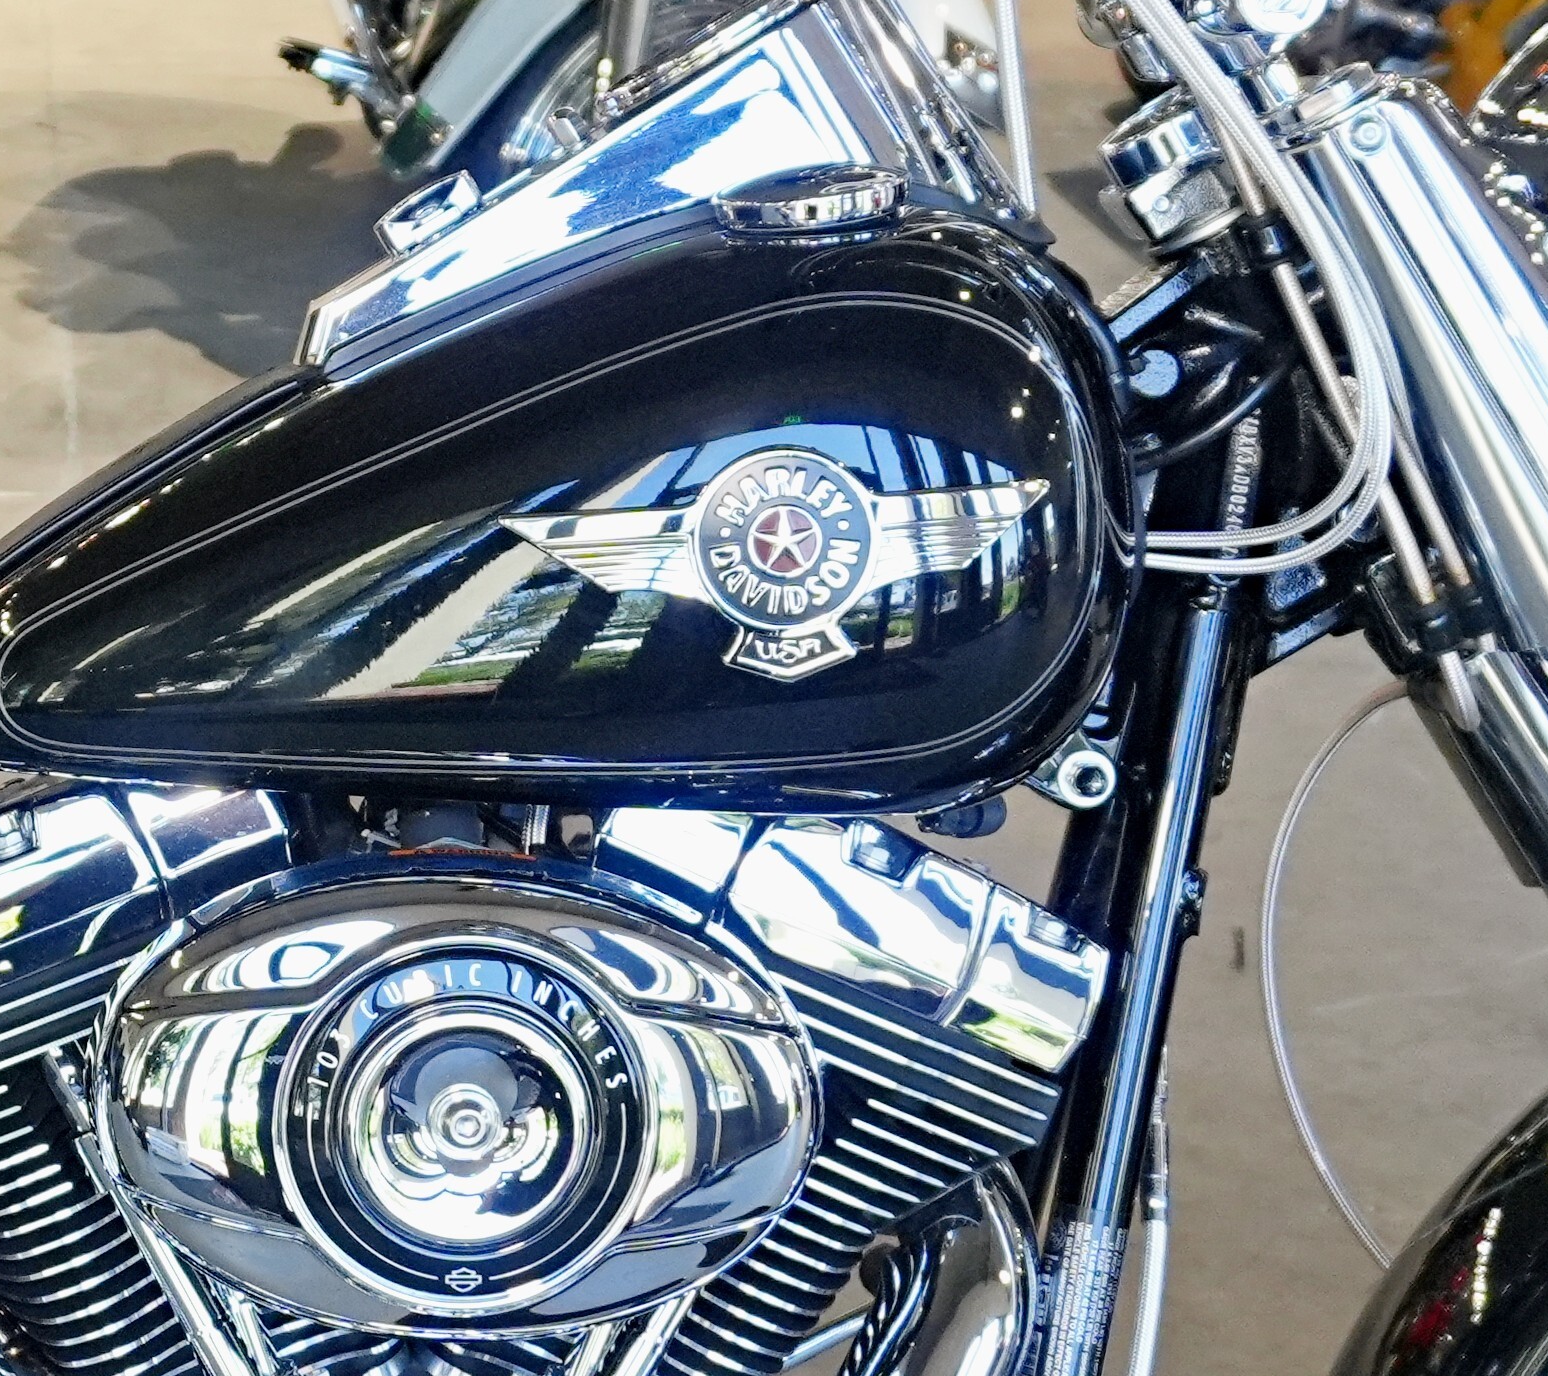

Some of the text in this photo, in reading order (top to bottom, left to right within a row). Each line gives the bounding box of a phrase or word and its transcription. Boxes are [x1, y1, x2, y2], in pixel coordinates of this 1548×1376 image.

[715, 466, 853, 527] HARLEY
[709, 538, 861, 615] DAVIDSON
[754, 637, 822, 664] USA
[307, 962, 628, 1090] 103 CUIC INCHES
[1066, 1219, 1076, 1235] THE
[1072, 1220, 1085, 1254] VEHICLE
[1083, 1222, 1093, 1241] THIS
[1063, 1235, 1074, 1257] DATE
[1077, 1241, 1090, 1274] VEHICLE
[1061, 1256, 1070, 1268] OF
[1066, 1253, 1079, 1285] SAFETY
[1059, 1284, 1074, 1330] STANDARDS
[1070, 1273, 1085, 1318] CONFORMS
[1065, 1329, 1075, 1345] ALL
[1068, 1317, 1077, 1329] TO
[1052, 1339, 1065, 1369] EFFECT
